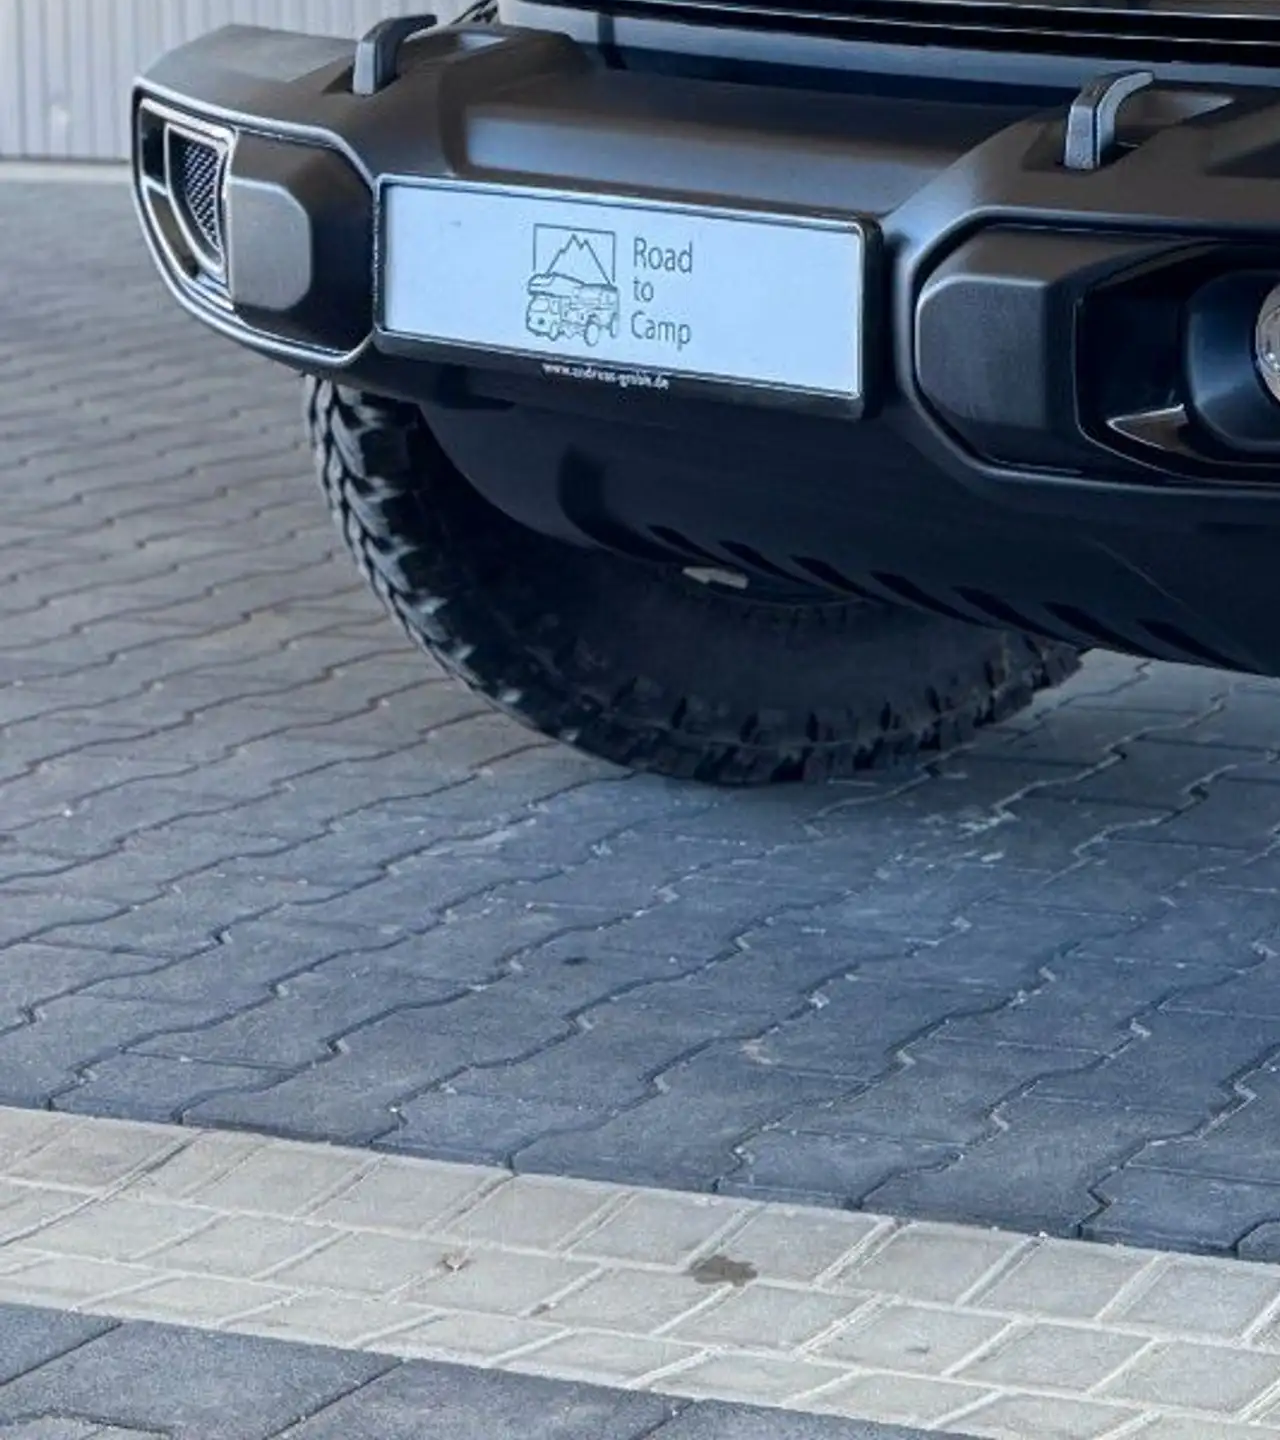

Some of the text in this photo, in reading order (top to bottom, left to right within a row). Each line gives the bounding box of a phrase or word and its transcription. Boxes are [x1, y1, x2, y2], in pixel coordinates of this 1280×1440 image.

[633, 237, 692, 273] Road
[633, 276, 654, 302] to
[631, 310, 692, 352] Camp
